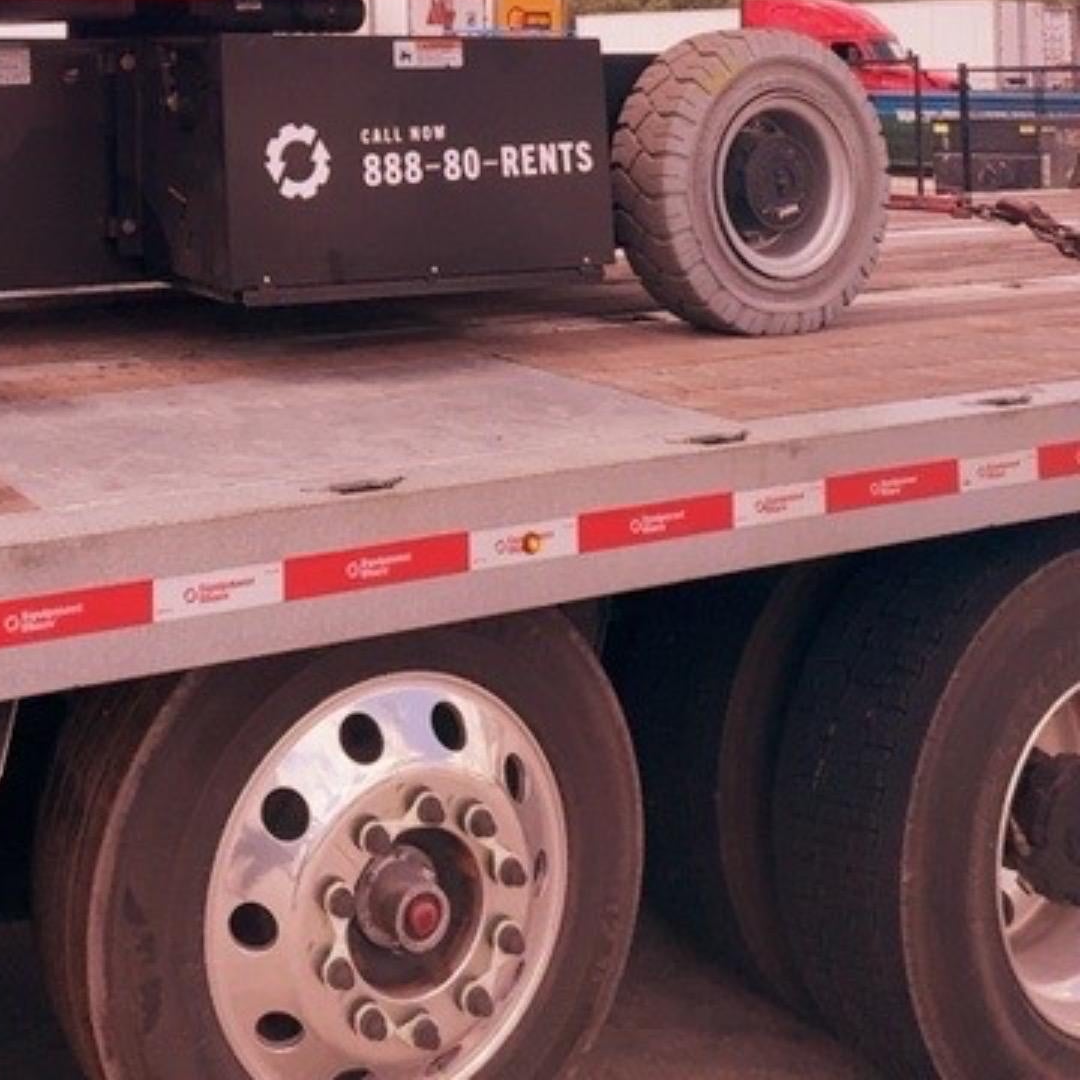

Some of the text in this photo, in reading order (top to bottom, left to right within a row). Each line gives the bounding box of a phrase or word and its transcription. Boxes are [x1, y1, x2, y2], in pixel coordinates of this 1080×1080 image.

[360, 124, 446, 145] CALL NOW
[363, 140, 594, 187] 888-80-RENTS
